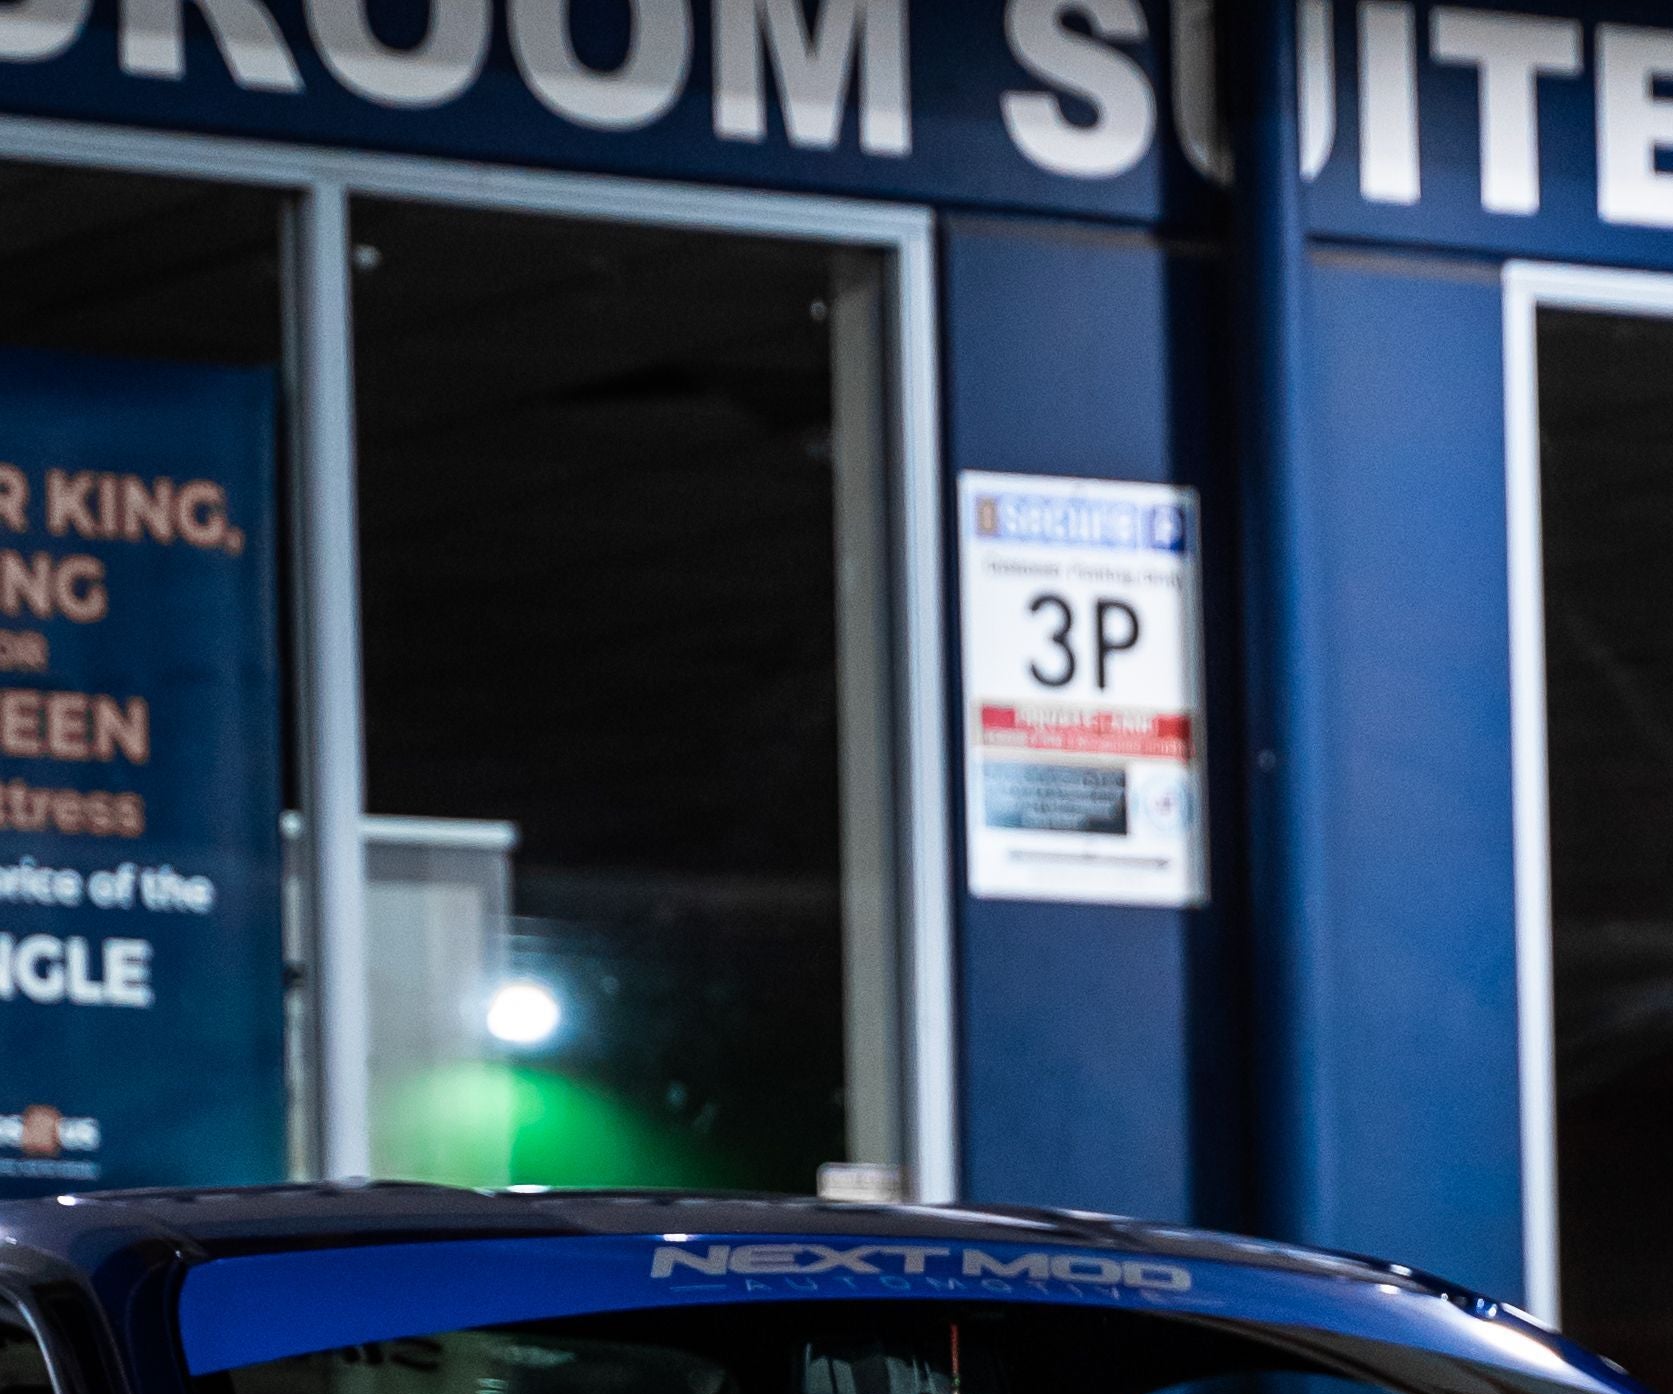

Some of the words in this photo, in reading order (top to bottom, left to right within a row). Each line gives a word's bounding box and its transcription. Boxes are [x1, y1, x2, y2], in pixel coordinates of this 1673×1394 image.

[1028, 592, 1141, 691] 3P
[650, 1244, 949, 1279] NEXT
[963, 1248, 1191, 1291] MOD
